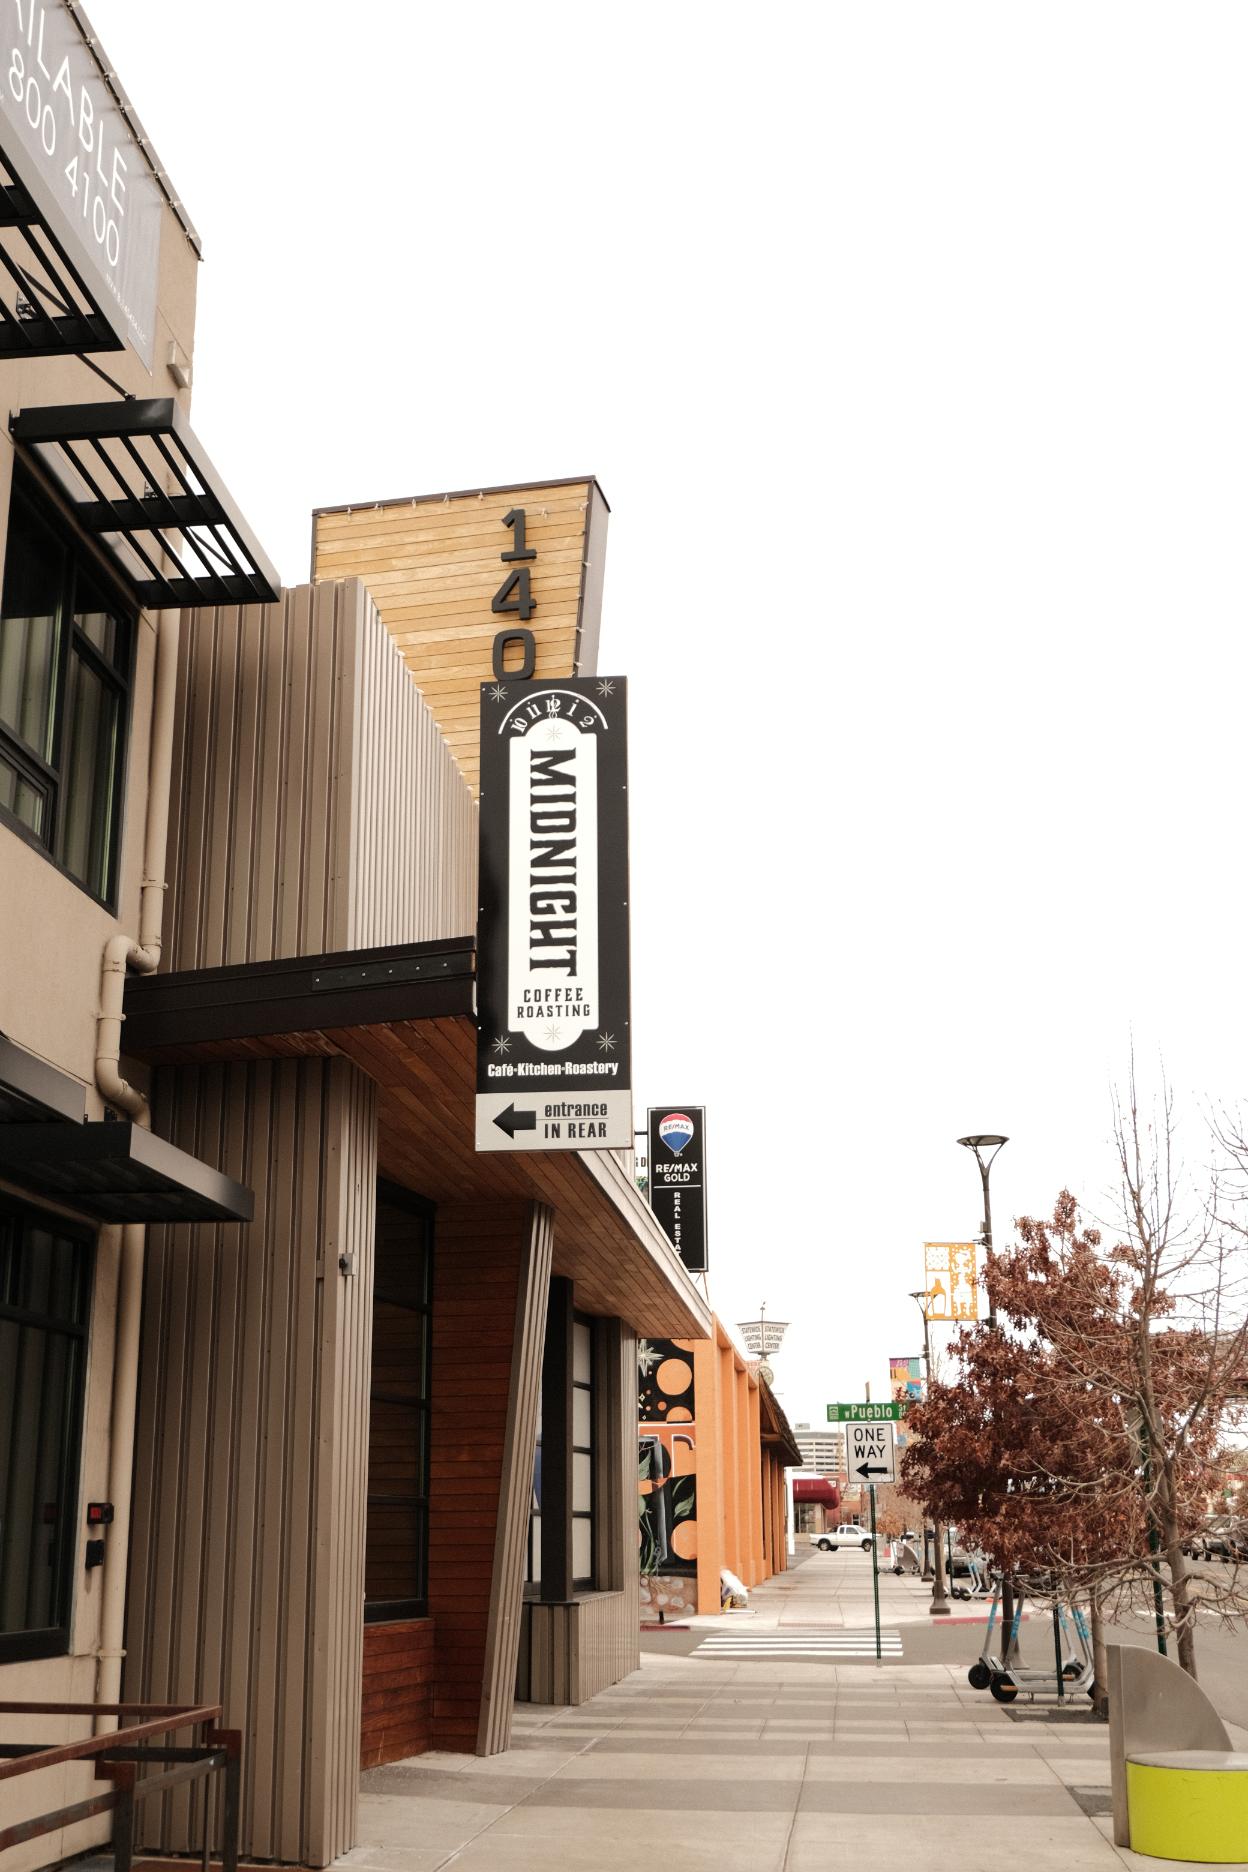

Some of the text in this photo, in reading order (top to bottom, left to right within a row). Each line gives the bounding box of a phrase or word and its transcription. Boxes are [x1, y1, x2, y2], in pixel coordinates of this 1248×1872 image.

[9, 48, 120, 267] 800 4100
[491, 508, 537, 681] 140
[530, 747, 577, 977] MIDNIGHT
[523, 987, 584, 1003] COFFEE
[517, 1004, 591, 1019] ROASTING
[544, 1101, 608, 1117] entrance
[544, 1122, 607, 1139] IN REAR
[663, 1123, 690, 1131] RE/MAX
[655, 1163, 698, 1173] RE/MAX
[664, 1173, 691, 1182] GOLD
[673, 1191, 681, 1219] REAL
[851, 1404, 893, 1419] Pueblo
[854, 1428, 886, 1442] ONE
[854, 1445, 886, 1458] WAY
